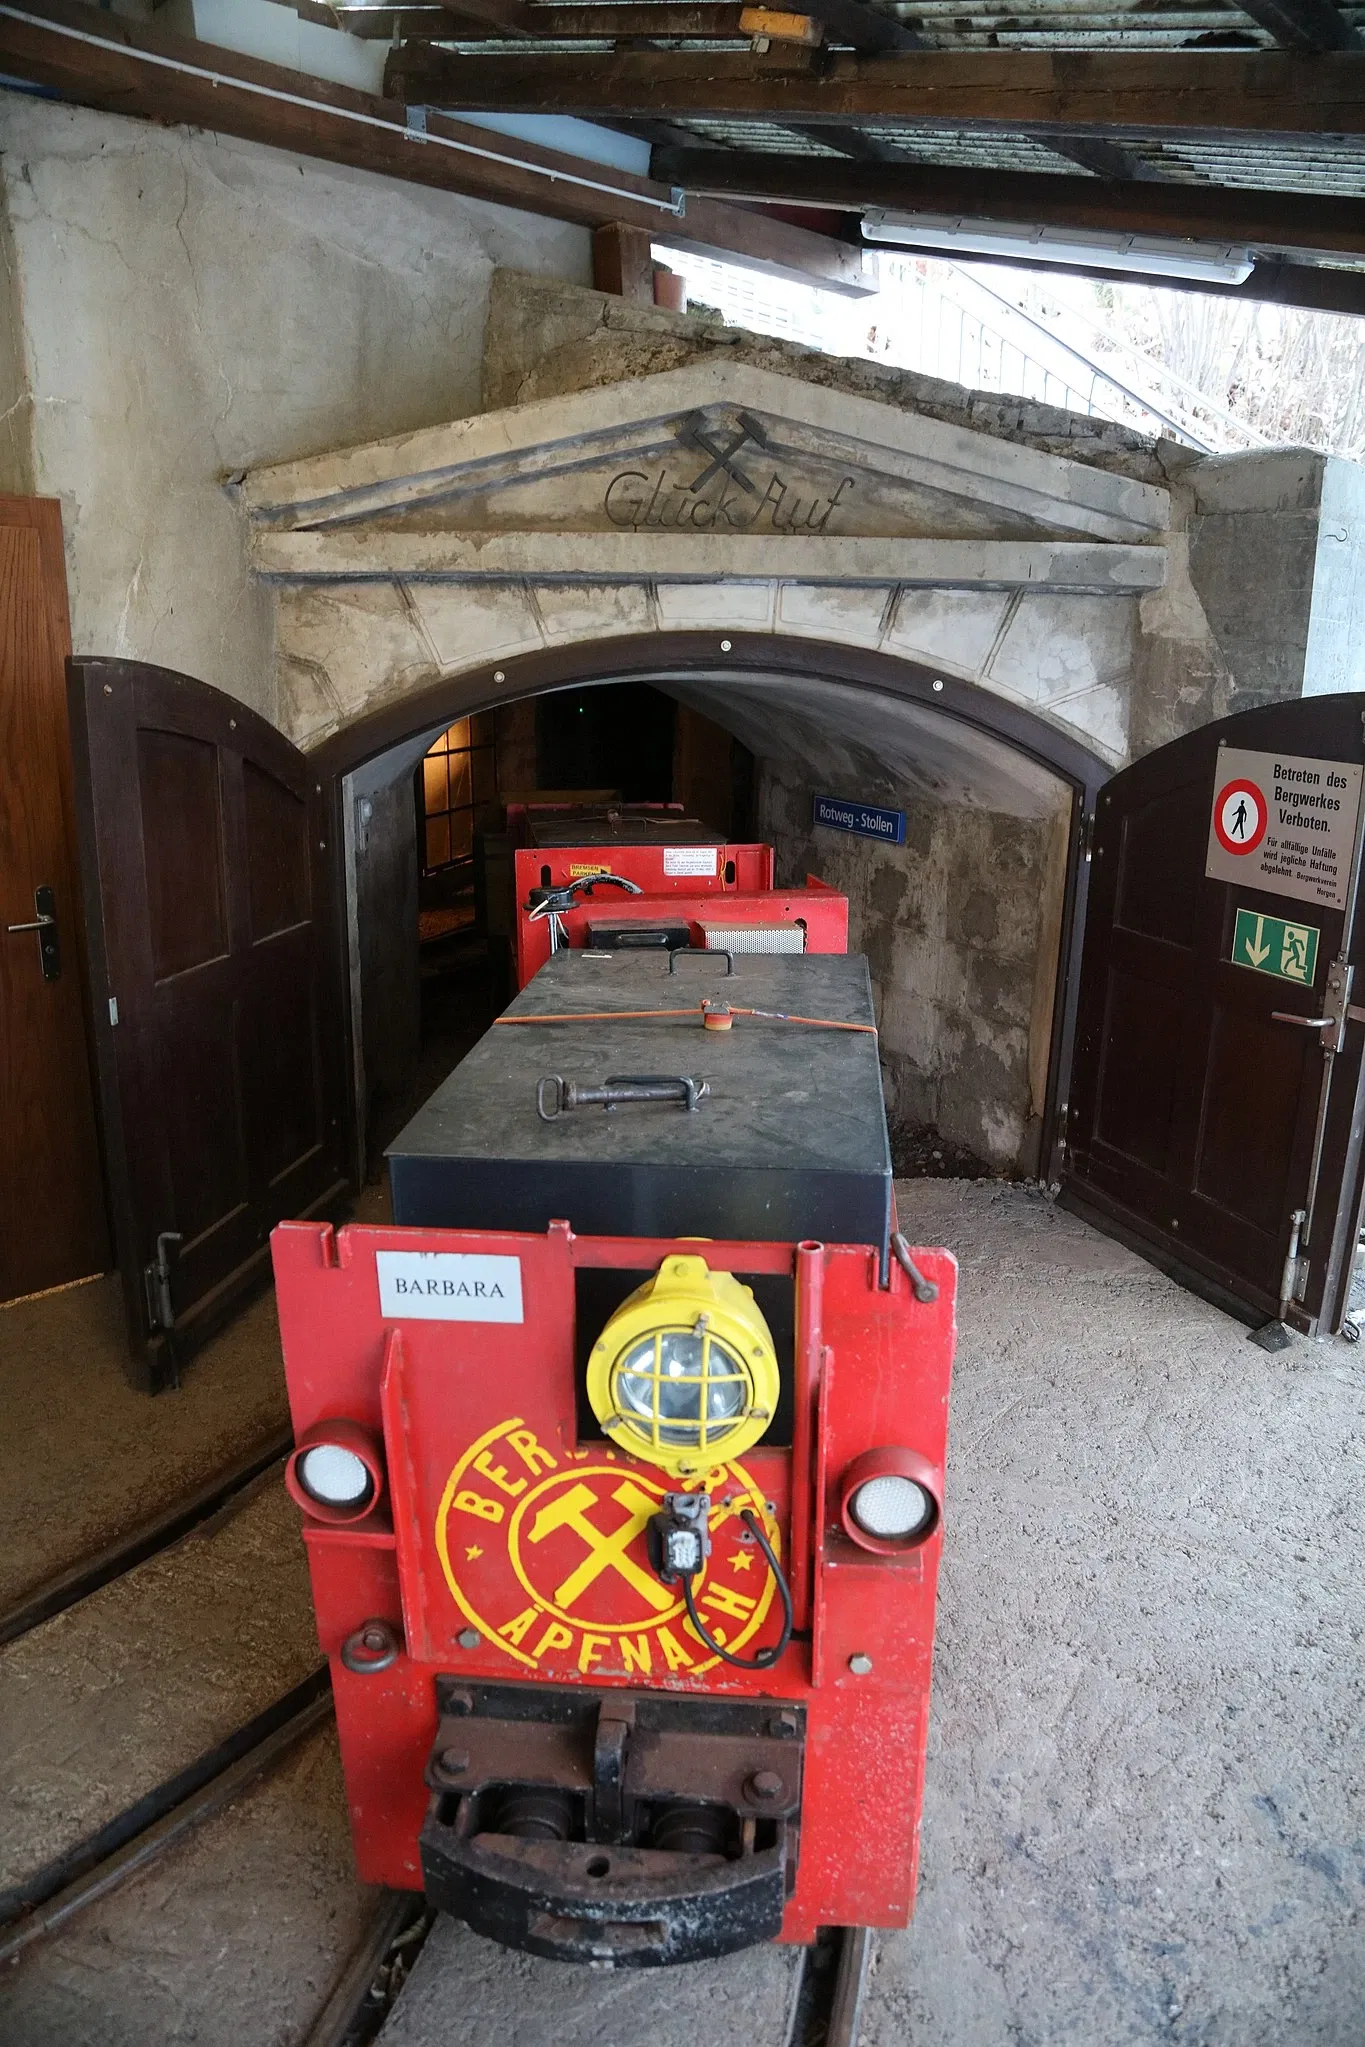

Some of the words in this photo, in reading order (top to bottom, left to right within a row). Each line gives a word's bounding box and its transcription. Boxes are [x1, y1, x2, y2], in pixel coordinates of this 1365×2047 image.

[605, 469, 746, 528] Glück
[751, 471, 855, 532] Auf
[1273, 764, 1320, 785] Betreten
[1326, 771, 1348, 789] des
[1274, 786, 1341, 811] Bergwerkes
[819, 804, 854, 828] Rotweg
[861, 812, 893, 833] Stollen
[1279, 808, 1331, 833] Verboten.
[1267, 836, 1278, 848] Für
[1280, 840, 1309, 855] allfällige
[1312, 845, 1337, 860] Unfälle
[571, 864, 599, 872] BREMSEN
[1263, 850, 1278, 861] wird
[1280, 853, 1307, 866] jegliche
[1309, 858, 1338, 876] Haftung
[1296, 871, 1337, 888] Bergwerkverein
[1316, 887, 1336, 899] Horgen
[395, 1277, 504, 1299] BARBARA
[453, 1429, 761, 1533] BERRK
